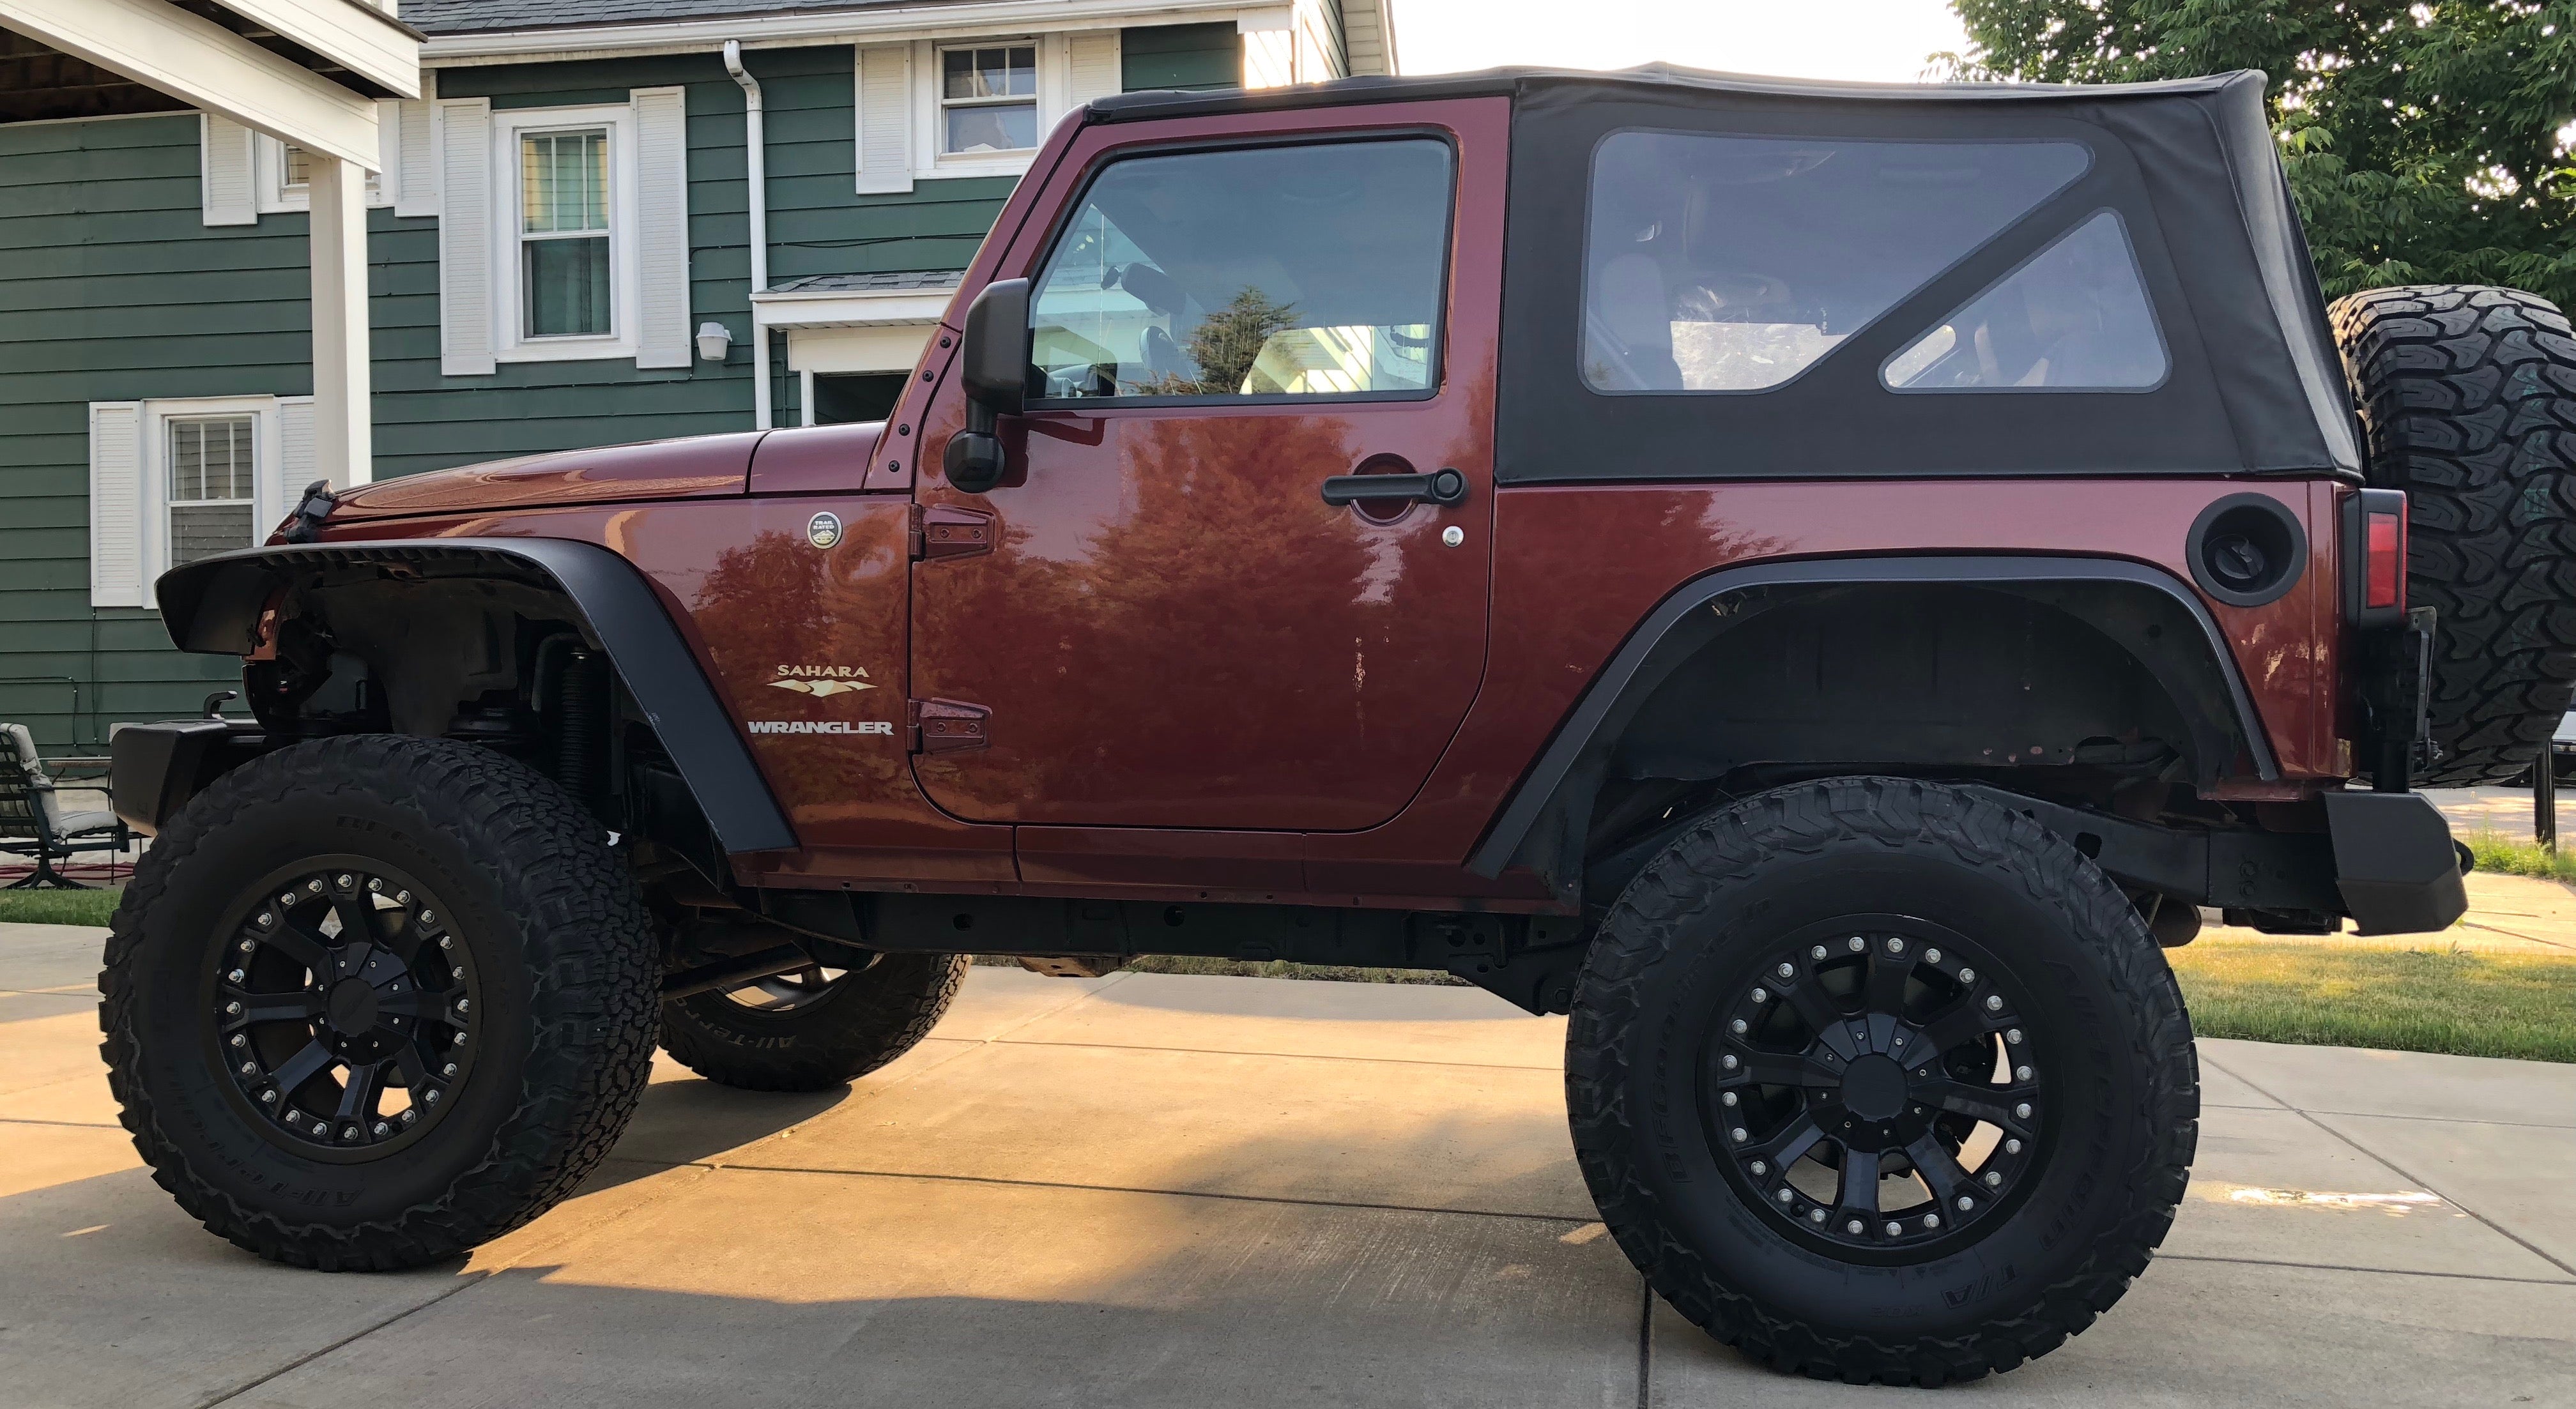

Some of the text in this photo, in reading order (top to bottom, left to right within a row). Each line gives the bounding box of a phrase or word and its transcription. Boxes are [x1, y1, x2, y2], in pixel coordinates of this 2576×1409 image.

[778, 664, 870, 678] SAHARA
[747, 721, 894, 735] WRANGLER
[1650, 895, 1779, 1182] BFGoodrich
[1940, 1261, 2020, 1309] T/A
